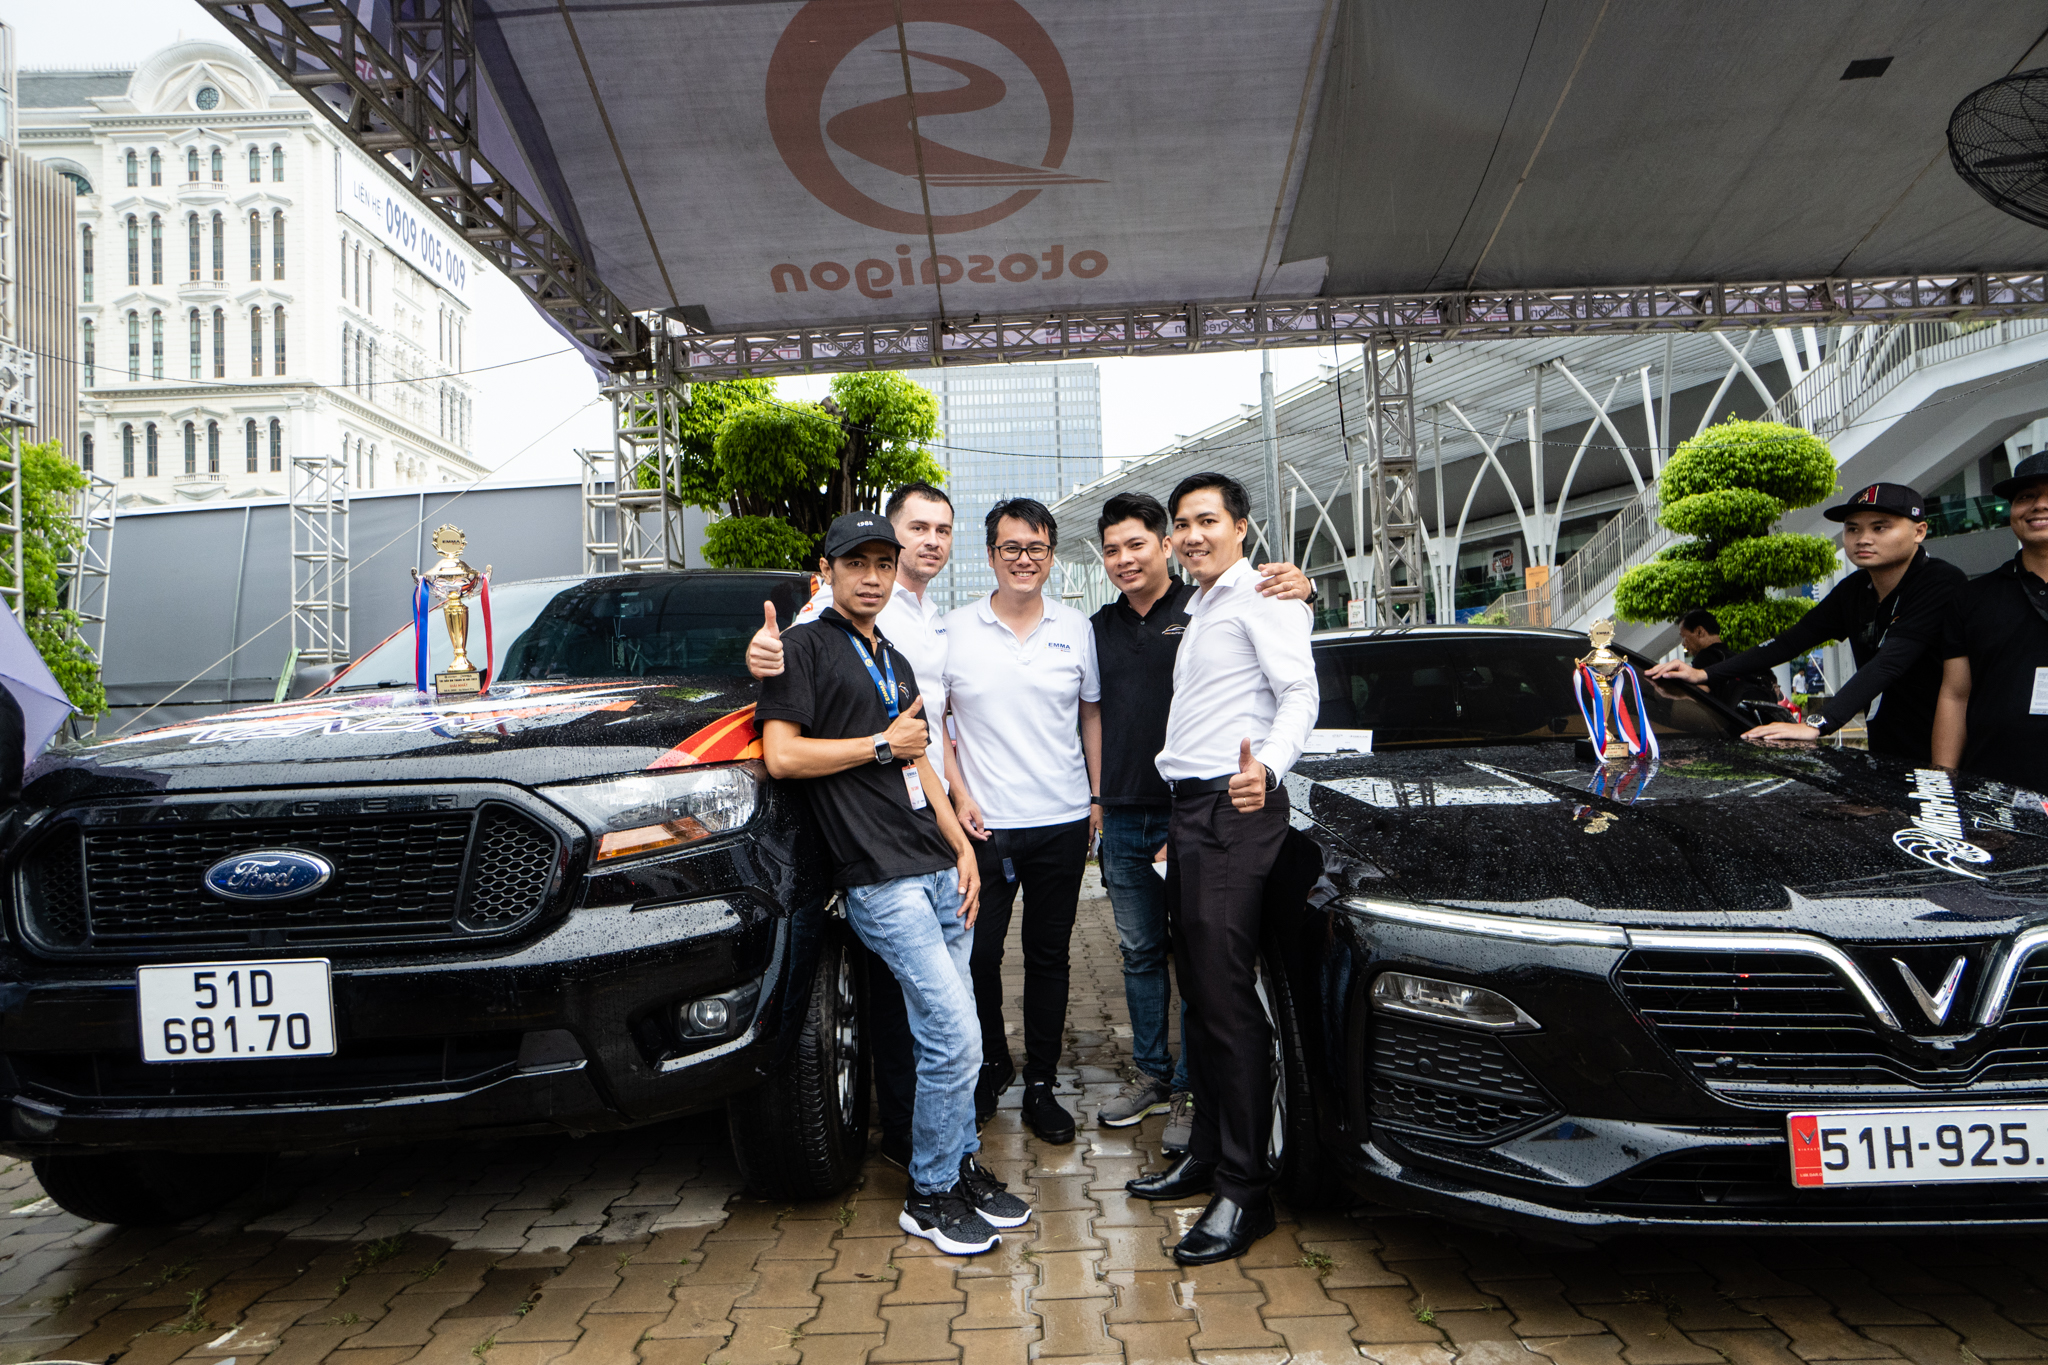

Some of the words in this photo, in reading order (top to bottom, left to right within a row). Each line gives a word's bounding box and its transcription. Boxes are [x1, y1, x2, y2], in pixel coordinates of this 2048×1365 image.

[386, 197, 417, 252] 0909
[421, 227, 442, 273] 005
[446, 248, 466, 291] 009
[1048, 642, 1071, 650] EMMA
[228, 859, 297, 889] Ford
[193, 969, 274, 1009] 51D
[163, 1012, 311, 1055] 681.70
